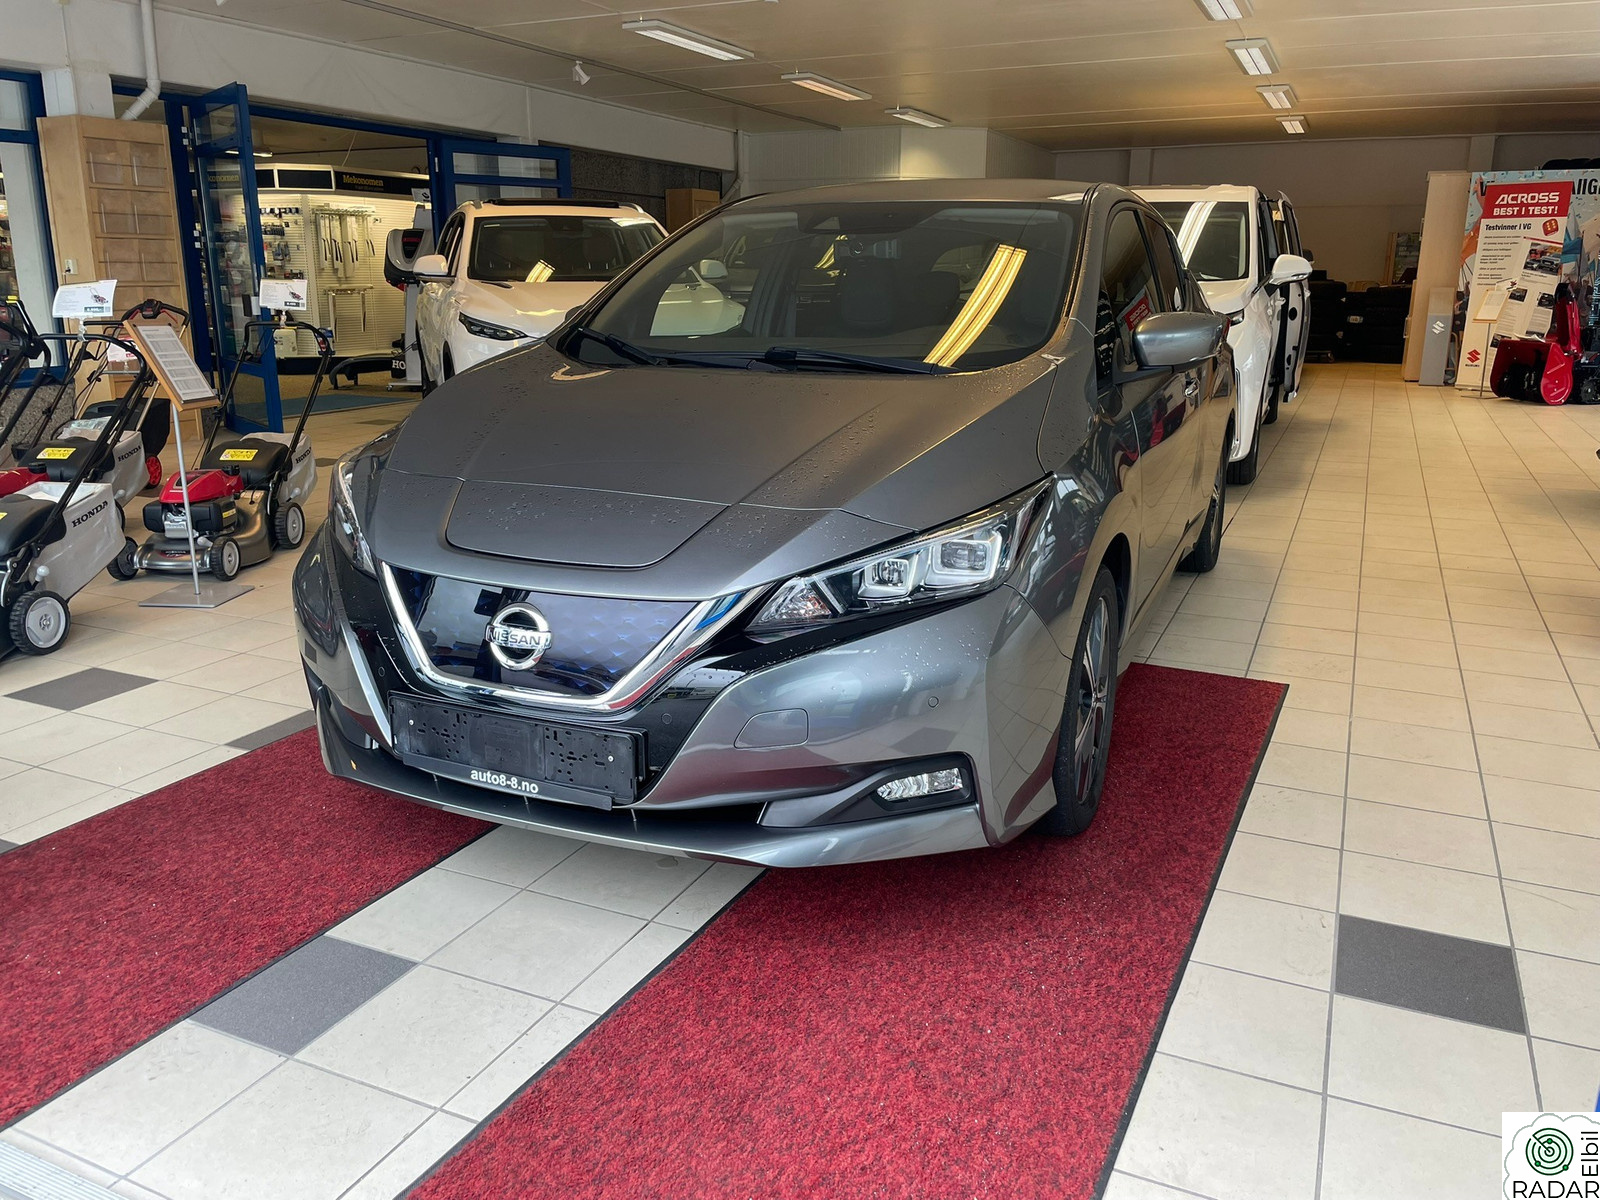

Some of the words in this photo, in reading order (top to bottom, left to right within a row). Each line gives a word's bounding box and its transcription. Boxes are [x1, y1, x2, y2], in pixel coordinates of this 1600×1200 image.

[342, 175, 383, 186] Mekonomen
[1495, 192, 1560, 205] ACROSS
[1493, 207, 1519, 216] BEST
[1528, 206, 1558, 215] TEST!
[1485, 223, 1517, 231] Testvinner
[118, 445, 142, 462] HONDA
[72, 500, 108, 528] HONDA
[488, 627, 541, 646] NISSAN
[470, 769, 539, 794] auto8-8.no
